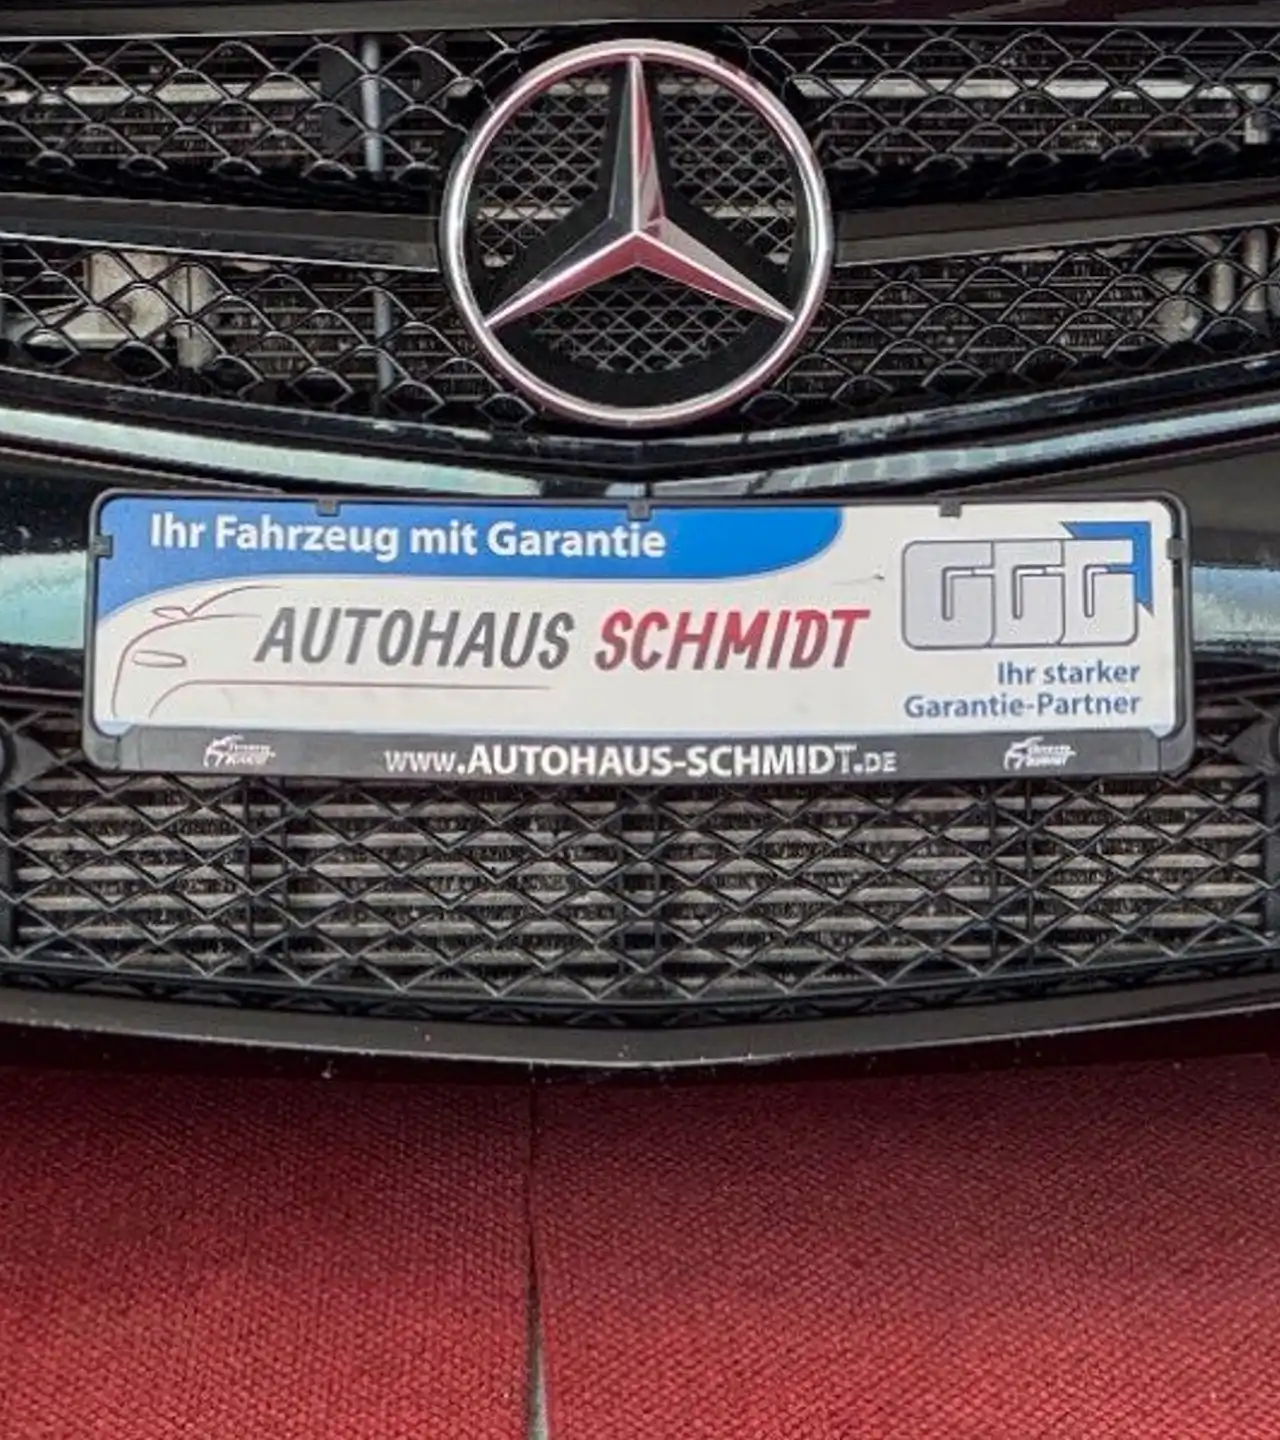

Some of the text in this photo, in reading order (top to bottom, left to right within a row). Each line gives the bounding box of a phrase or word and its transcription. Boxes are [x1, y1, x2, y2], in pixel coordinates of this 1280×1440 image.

[150, 513, 666, 561] Ihr Fahrzeug mit Garantie
[254, 607, 871, 672] AUTOHAUS SCHMIDT
[997, 660, 1141, 685] Ihr starker
[904, 692, 1141, 719] Garantie-Partner
